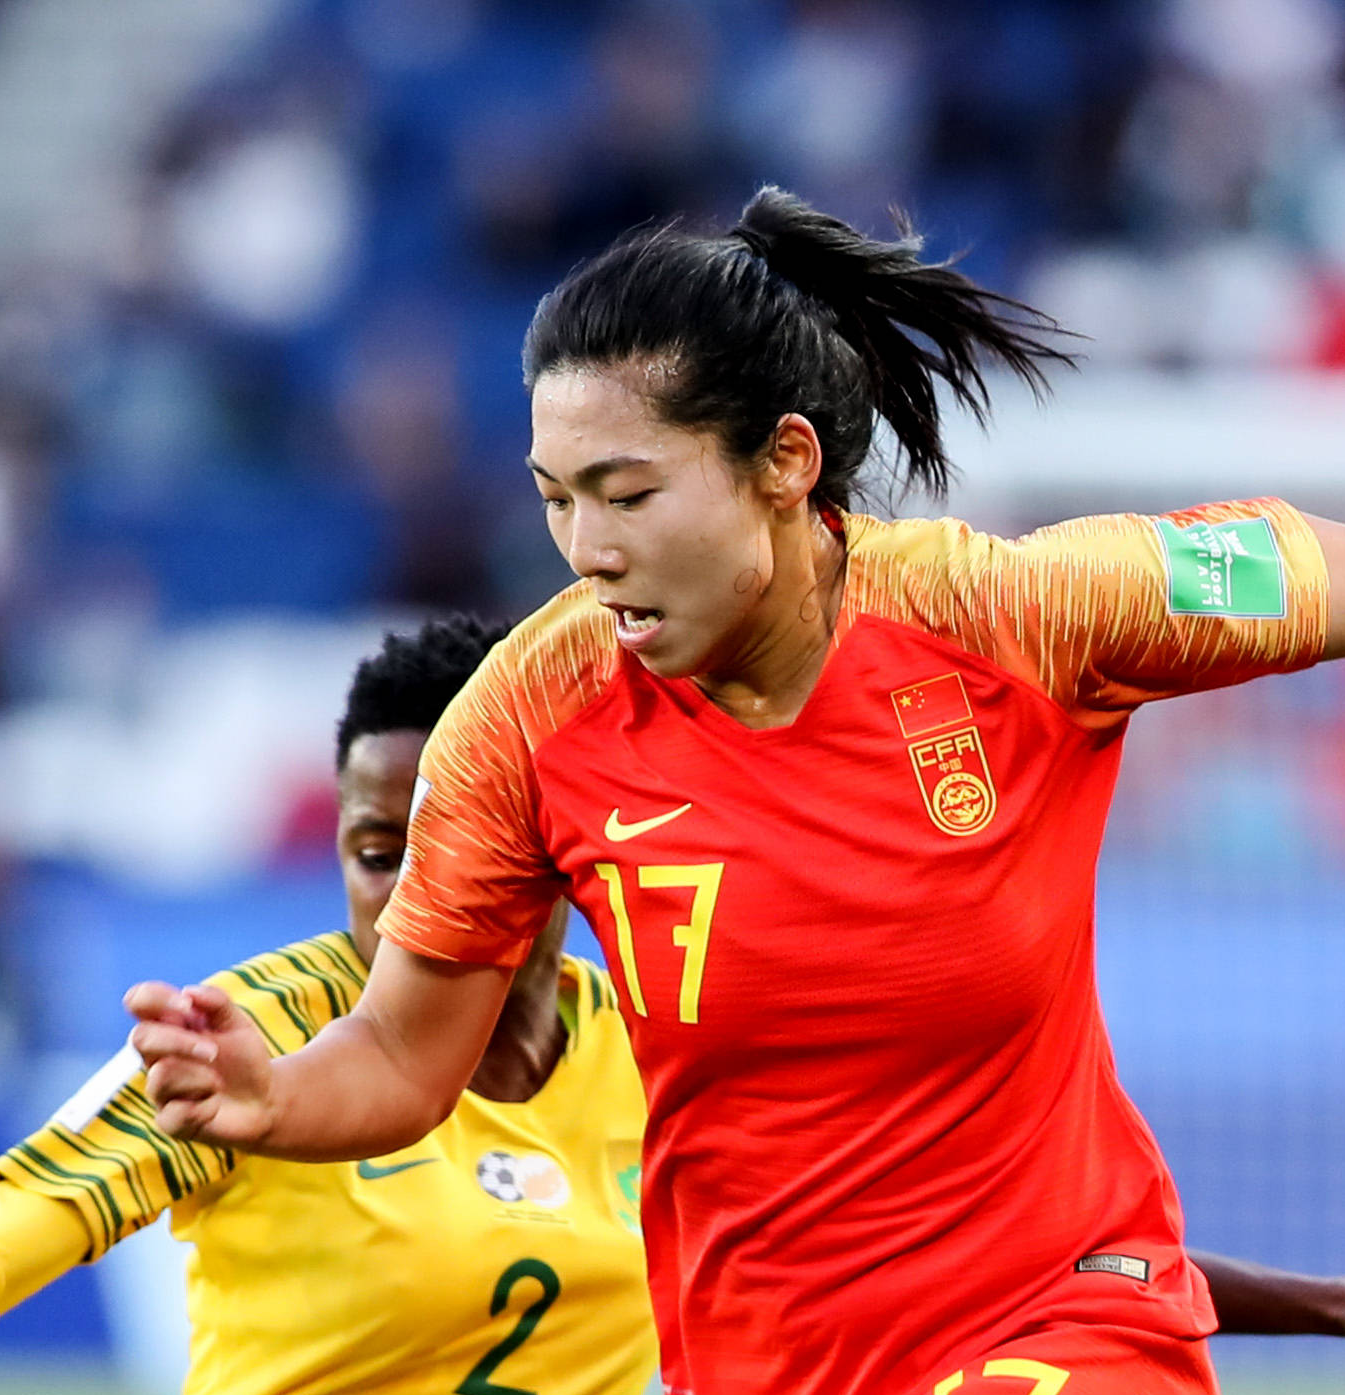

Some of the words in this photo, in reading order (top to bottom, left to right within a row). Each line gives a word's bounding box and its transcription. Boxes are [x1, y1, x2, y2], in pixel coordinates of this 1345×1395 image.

[1201, 528, 1224, 607] FOOTBALL
[915, 733, 976, 768] CFA
[594, 862, 725, 1025] 17
